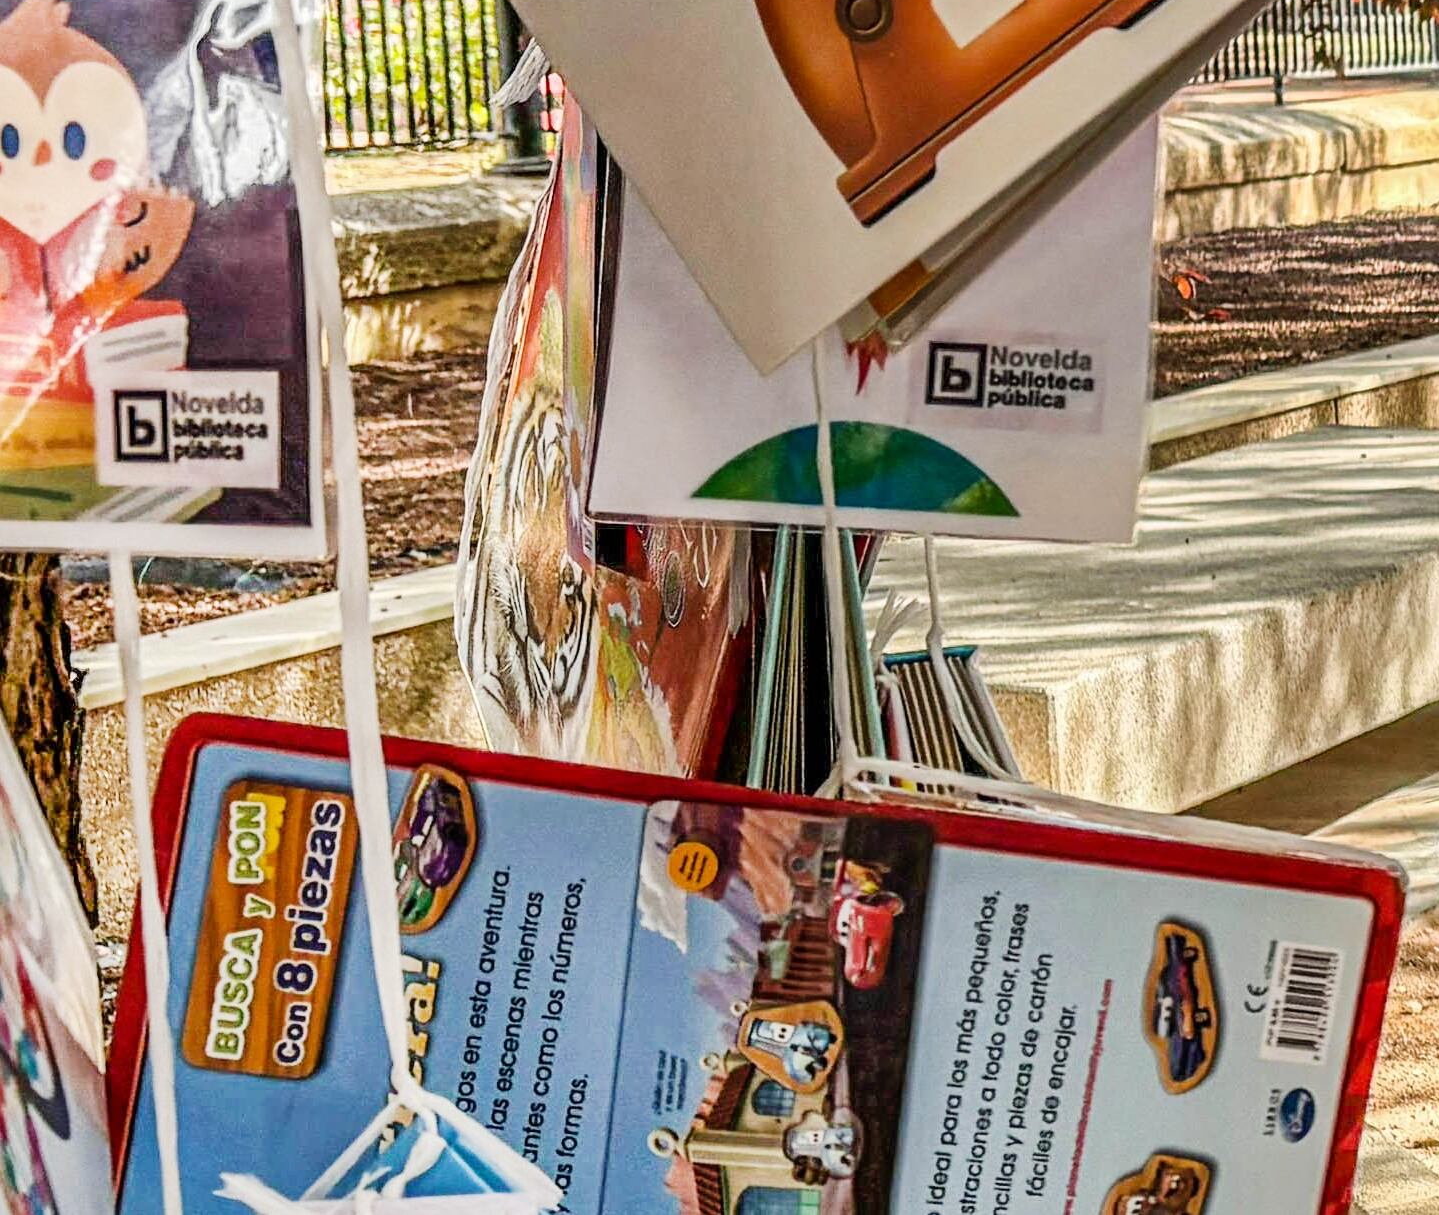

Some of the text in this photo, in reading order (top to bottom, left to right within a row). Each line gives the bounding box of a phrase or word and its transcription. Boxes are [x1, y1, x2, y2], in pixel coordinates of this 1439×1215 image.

[988, 369, 1096, 393] biblioteca
[989, 347, 1092, 372] Novelda
[172, 391, 266, 415] Novelda
[987, 388, 1066, 412] pública
[173, 418, 269, 439] biblioteca
[174, 441, 245, 464] pública
[214, 803, 274, 1055] BUSCA y PON
[274, 802, 341, 1065] Con 8 piezas
[477, 865, 510, 974] aventura.
[548, 877, 586, 984] números,
[1001, 903, 1029, 963] frases
[468, 979, 491, 1029] esta
[481, 891, 544, 1131] las escenas mientras
[540, 988, 565, 1021] los
[993, 968, 1020, 1026] color,
[1027, 953, 1053, 1023] cartón
[462, 1034, 482, 1065] en
[532, 1026, 559, 1097] como
[925, 890, 1001, 1205] ideal para los más pequeños,
[980, 1031, 1006, 1081] todo
[1019, 1027, 1039, 1058] de
[554, 1073, 588, 1158] formas.
[980, 1086, 996, 1102] a
[1006, 1062, 1033, 1129] piezas
[1024, 1005, 1077, 1197] fáciles de encajar.
[1005, 1133, 1024, 1147] y
